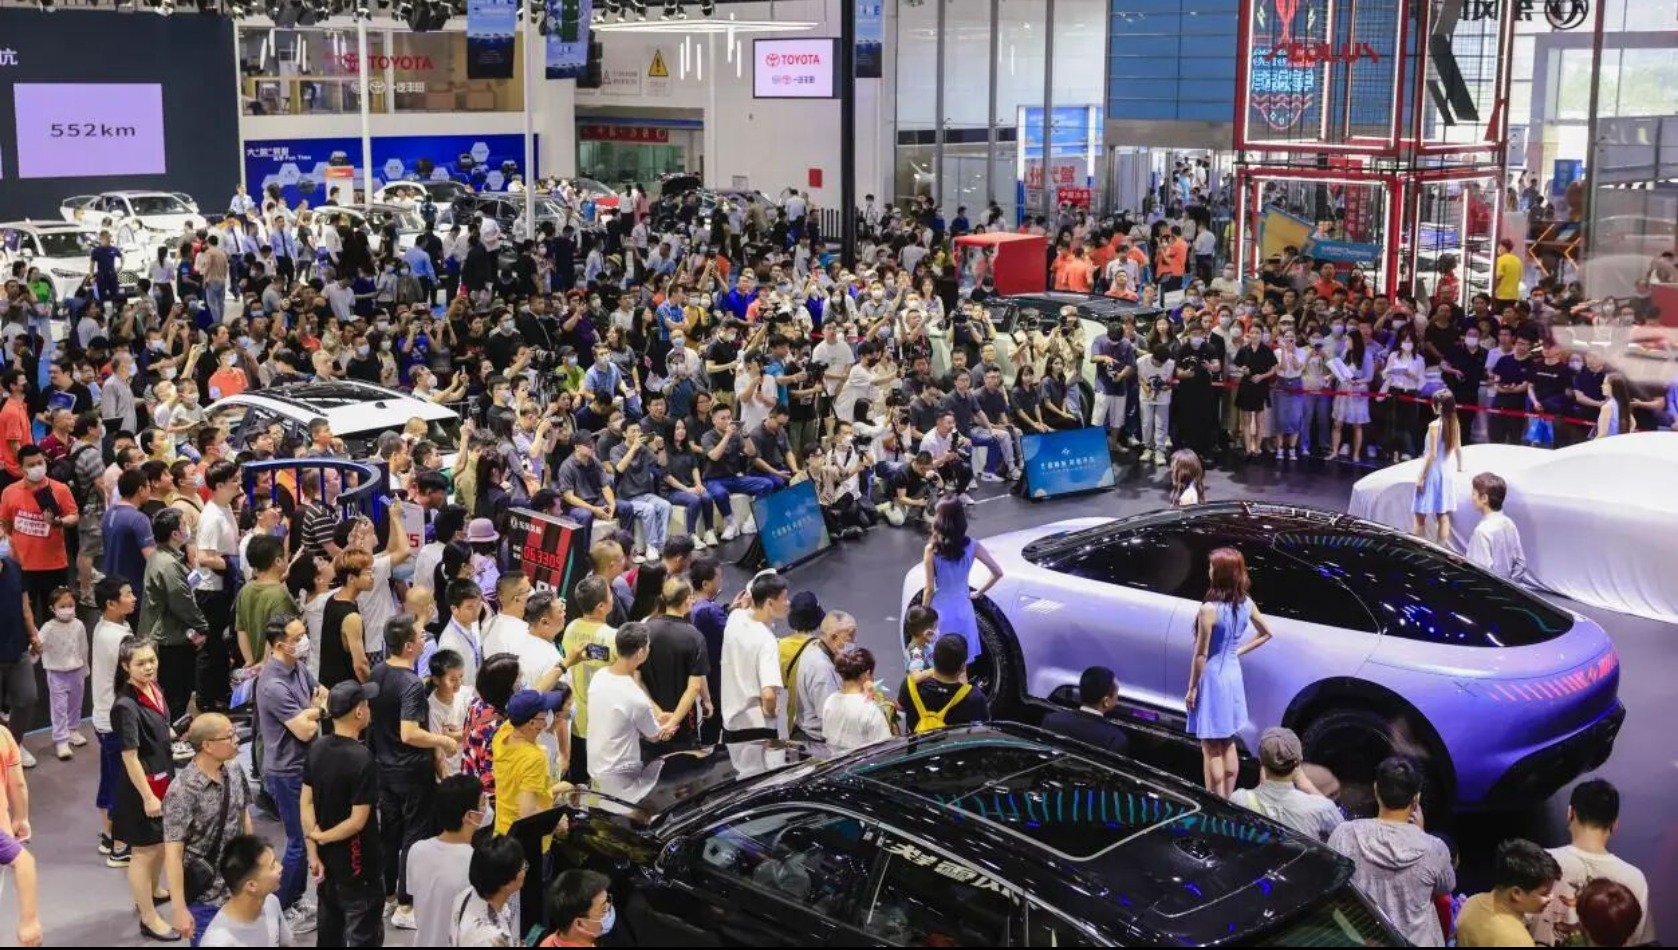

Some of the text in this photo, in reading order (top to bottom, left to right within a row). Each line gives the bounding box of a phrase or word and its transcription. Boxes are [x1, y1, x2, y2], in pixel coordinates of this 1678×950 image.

[368, 55, 434, 70] TOYOTA
[781, 54, 820, 65] TOYOTA
[50, 123, 135, 138] 552km
